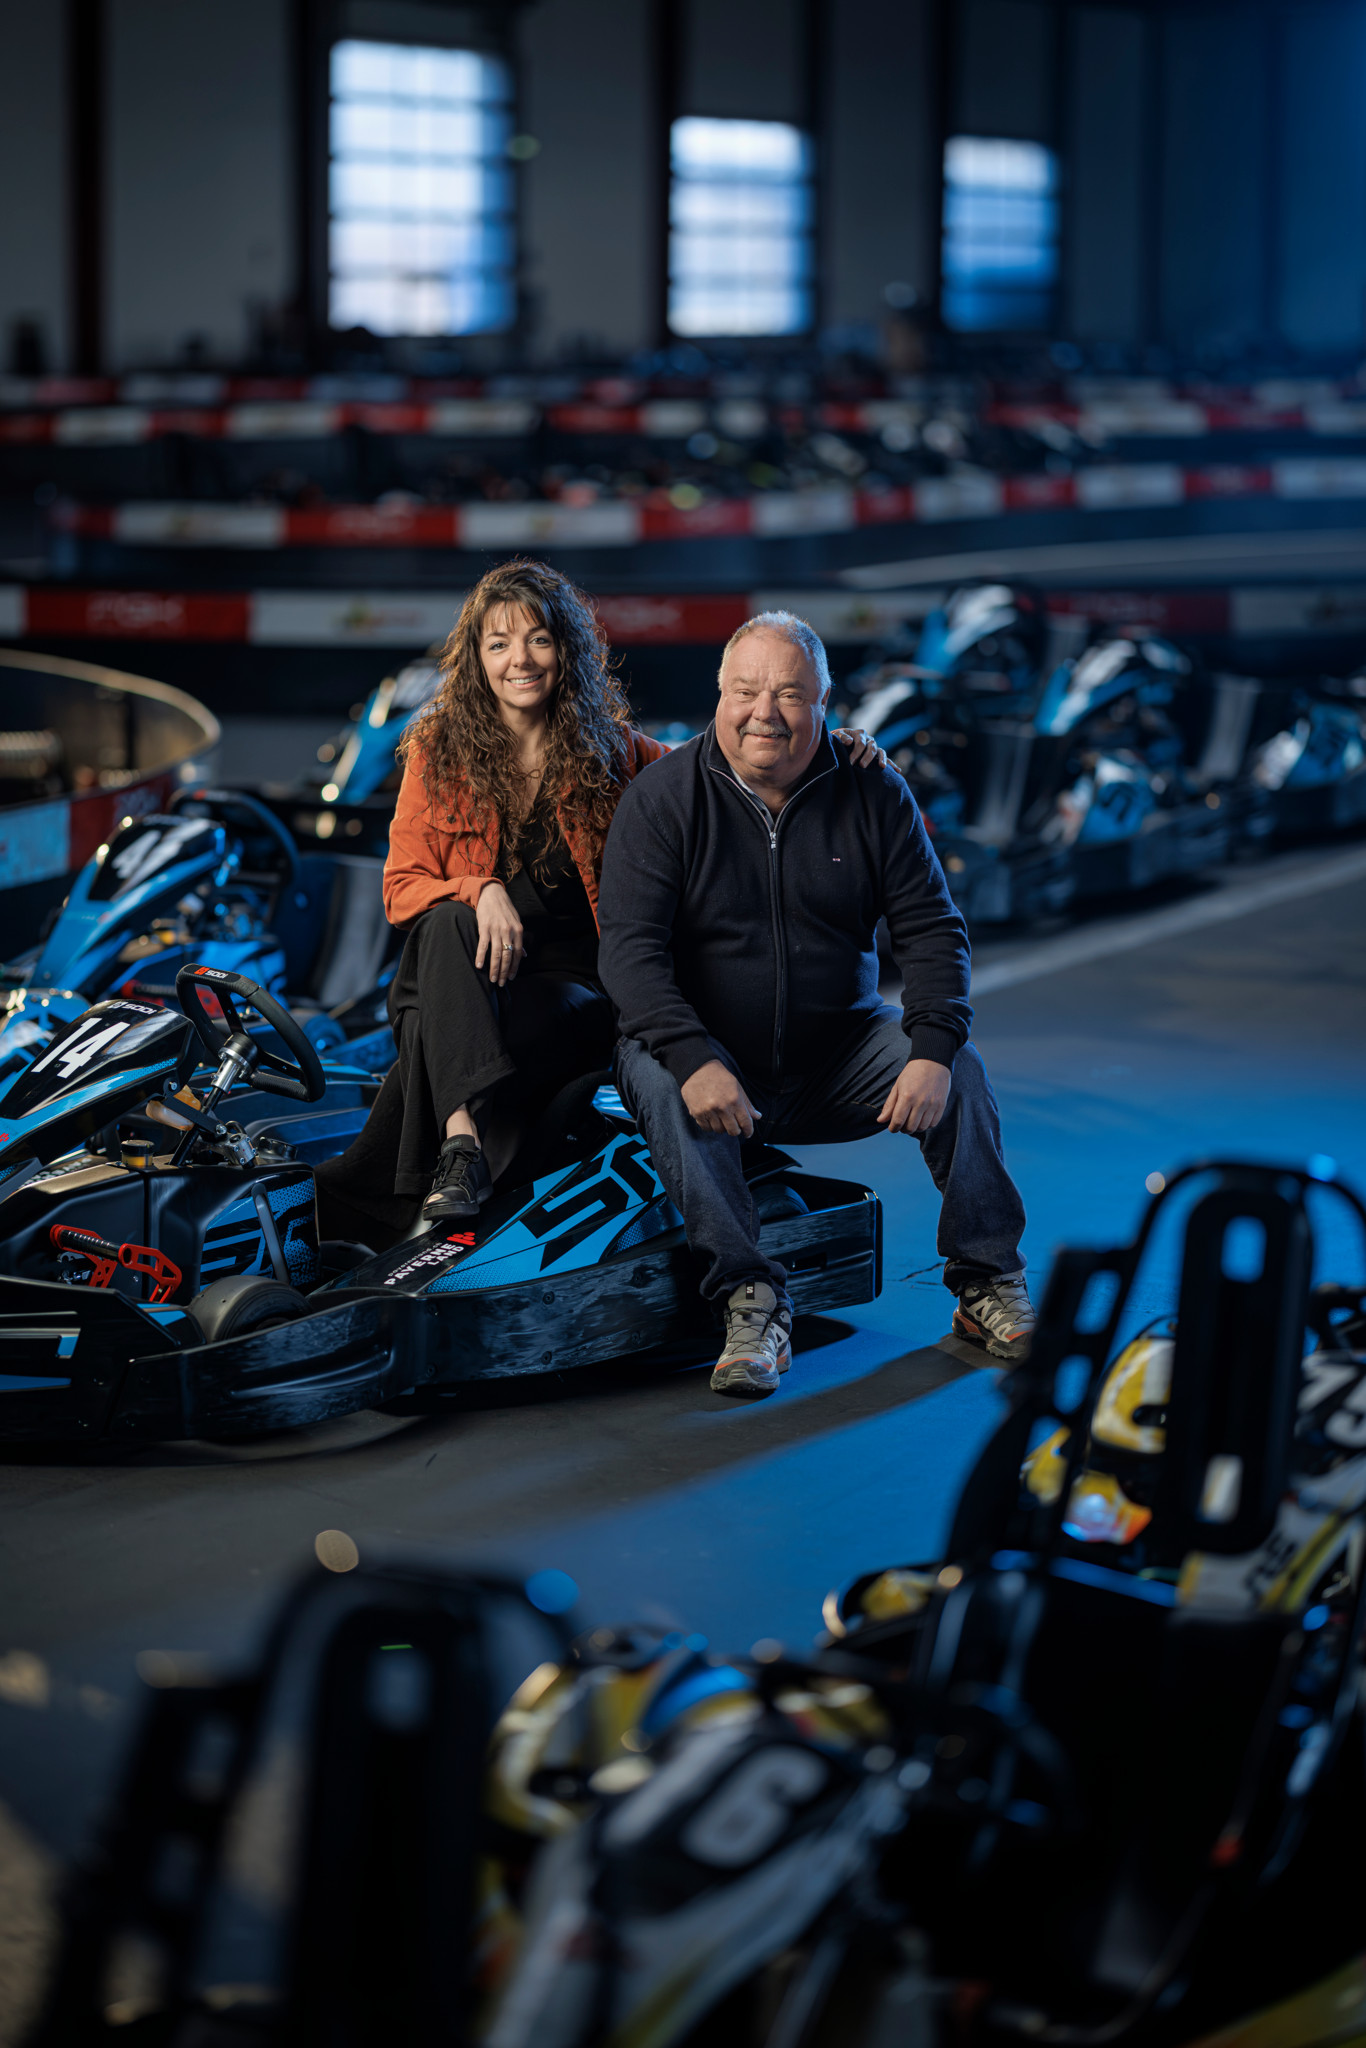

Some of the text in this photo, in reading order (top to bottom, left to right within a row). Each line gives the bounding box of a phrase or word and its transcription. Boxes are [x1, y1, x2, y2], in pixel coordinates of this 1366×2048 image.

[205, 969, 228, 979] SODI
[122, 1003, 157, 1015] SODI
[31, 1017, 131, 1079] 14
[383, 1243, 456, 1286] PAYERNE
[427, 1245, 464, 1266] LAND
